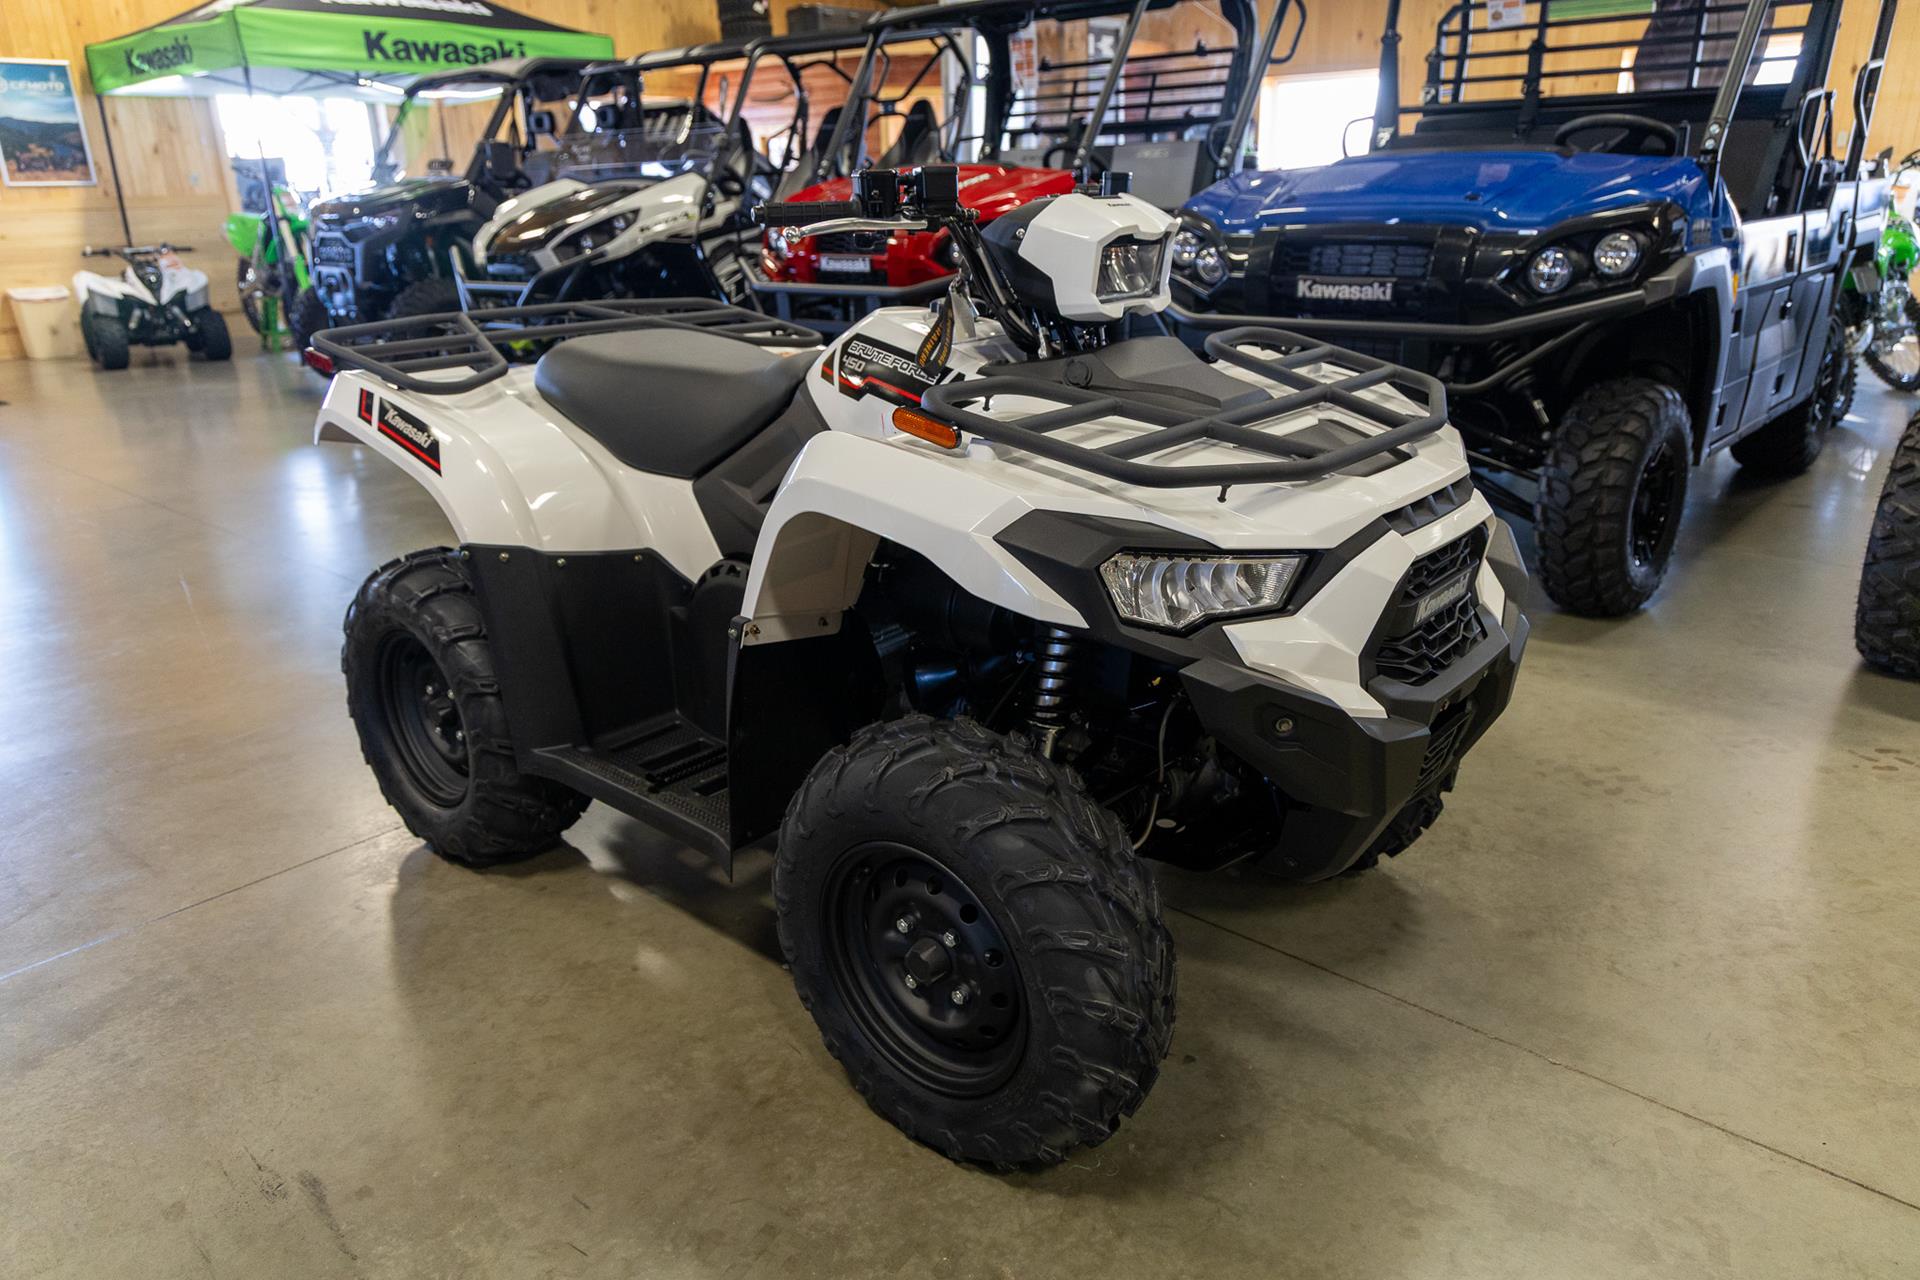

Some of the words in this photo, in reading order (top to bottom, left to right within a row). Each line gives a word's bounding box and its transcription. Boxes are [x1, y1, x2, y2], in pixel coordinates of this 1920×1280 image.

[1297, 279, 1393, 300] Kawasaki
[842, 354, 866, 373] 450
[847, 340, 892, 364] BRUTE
[384, 408, 434, 449] Kawasaki
[1416, 572, 1470, 622] Kawasaki
